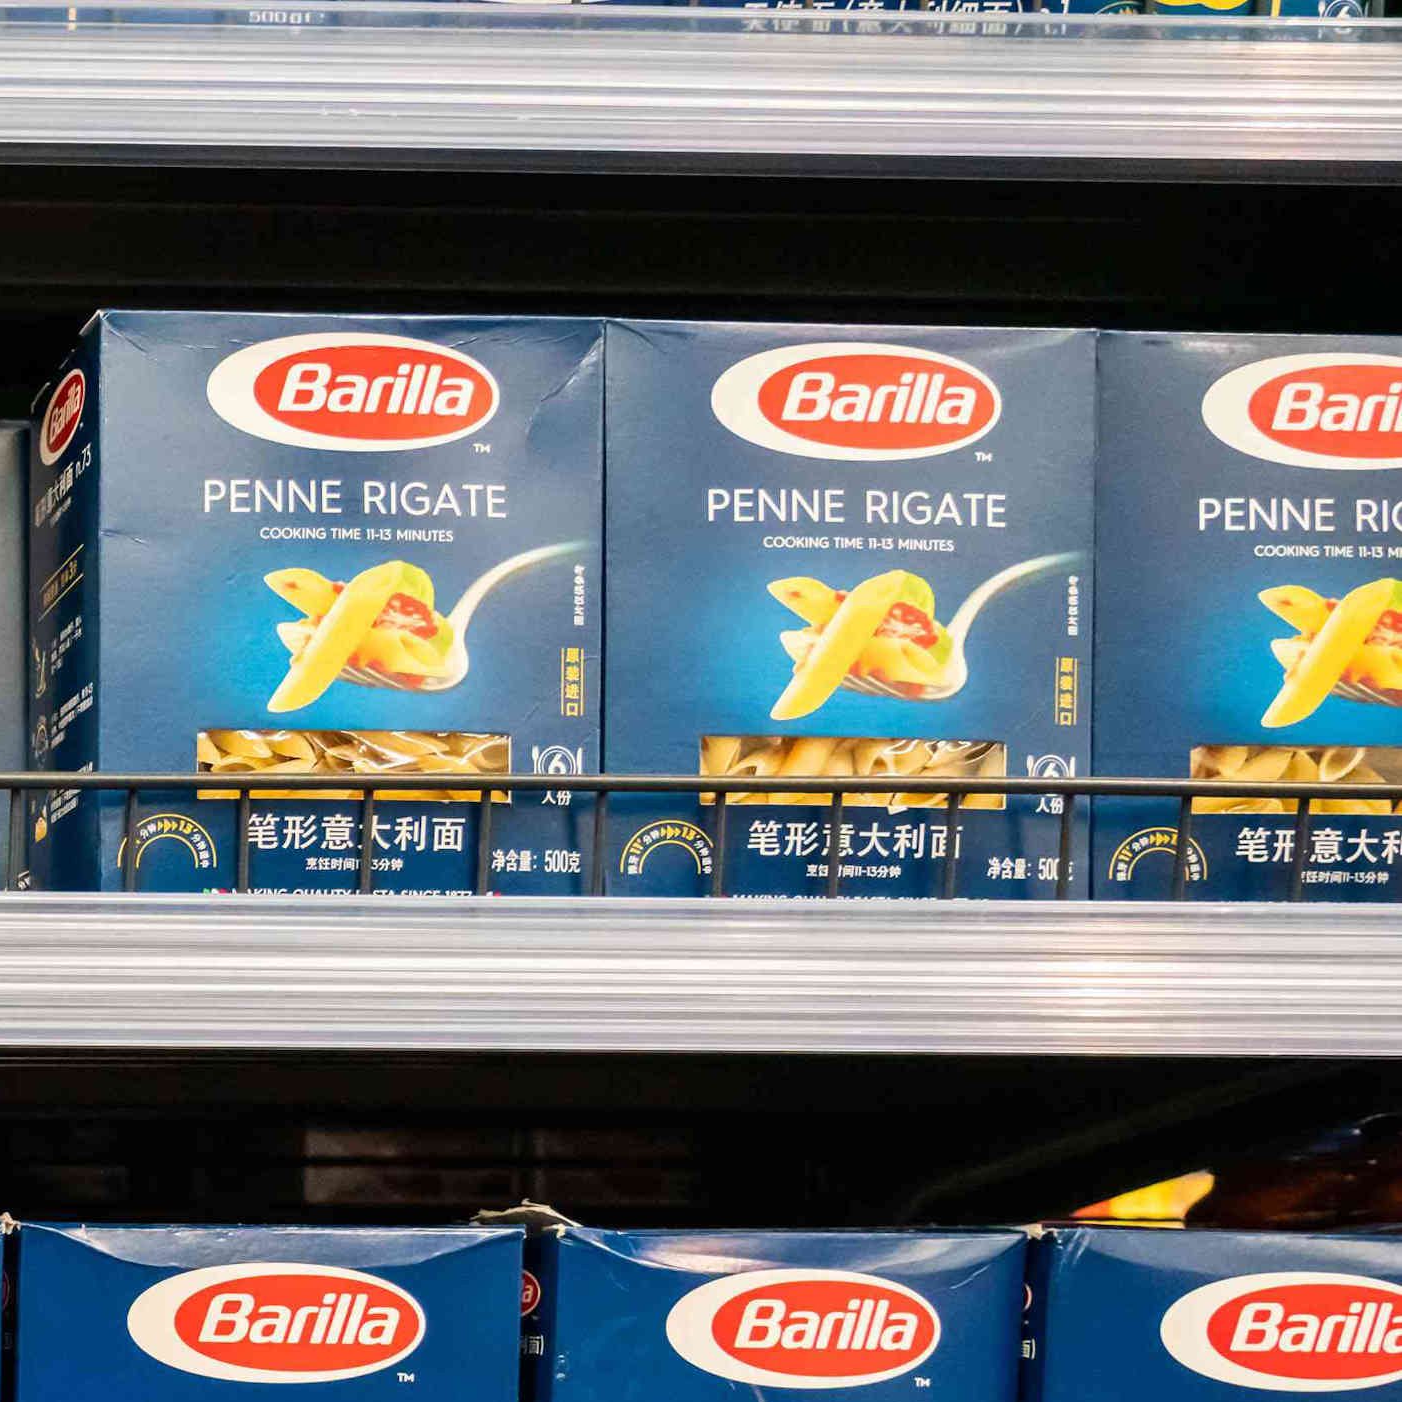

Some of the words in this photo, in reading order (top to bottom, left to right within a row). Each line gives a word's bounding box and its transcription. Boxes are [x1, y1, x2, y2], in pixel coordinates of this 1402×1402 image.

[278, 362, 475, 417] Barilla
[781, 372, 977, 426] Barilla
[204, 478, 341, 513] PENNE
[364, 481, 506, 518] RIGATE
[708, 489, 845, 522] PENNE
[867, 491, 1005, 527] RIGATE
[1199, 498, 1335, 531] PENNE
[260, 527, 326, 539] COOKING
[331, 528, 361, 540] TIME
[367, 529, 391, 540] 11-13
[397, 530, 453, 542] MINUTES
[247, 813, 465, 852] 笔形意大利面
[544, 851, 581, 873] 500克
[198, 1292, 399, 1345] Barilla
[734, 1298, 918, 1351] Barilla
